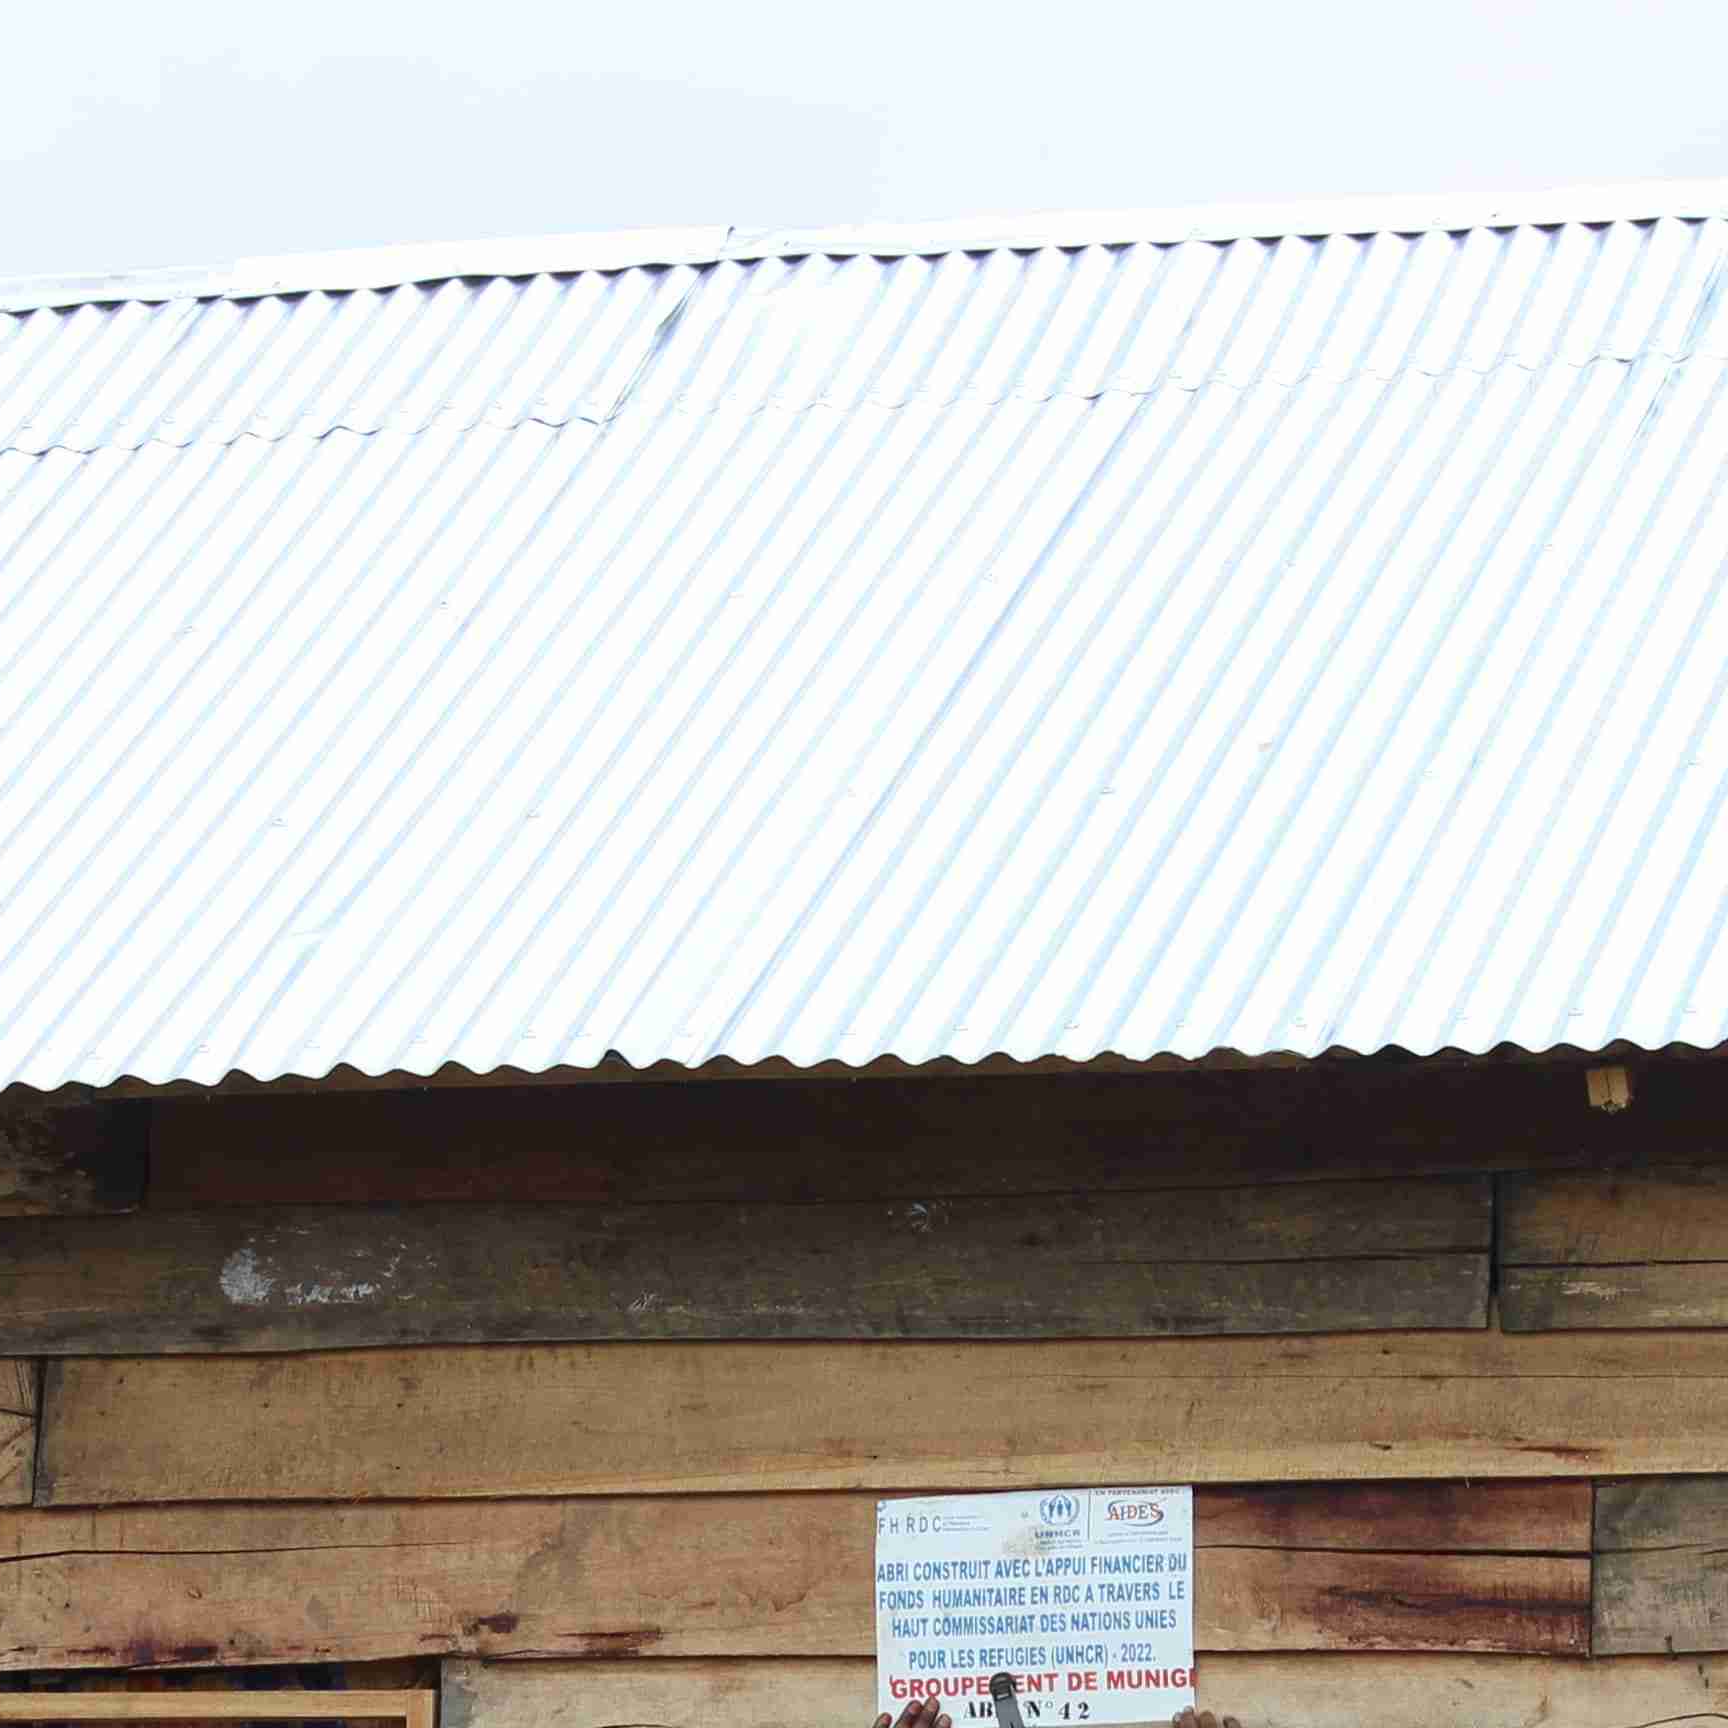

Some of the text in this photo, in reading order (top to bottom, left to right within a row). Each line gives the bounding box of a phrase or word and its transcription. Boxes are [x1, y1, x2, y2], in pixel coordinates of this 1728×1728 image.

[877, 1552, 1187, 1583] ABRI CONSTRUIT AVEC L'APPUI FINANCIER DU
[879, 1580, 1185, 1611] FONDS HUMANITAIRE EN RDC A TRAVERS LE
[892, 1609, 1177, 1638] HAUT COMMISSARIAT DES NATIONS UNIES
[909, 1649, 946, 1670] POUR
[951, 1648, 975, 1668] LES
[979, 1646, 1046, 1667] REFUGIES
[1051, 1643, 1108, 1669] (UNHCR)
[890, 1673, 1059, 1699] GROUPEENT
[1067, 1671, 1099, 1692] DE
